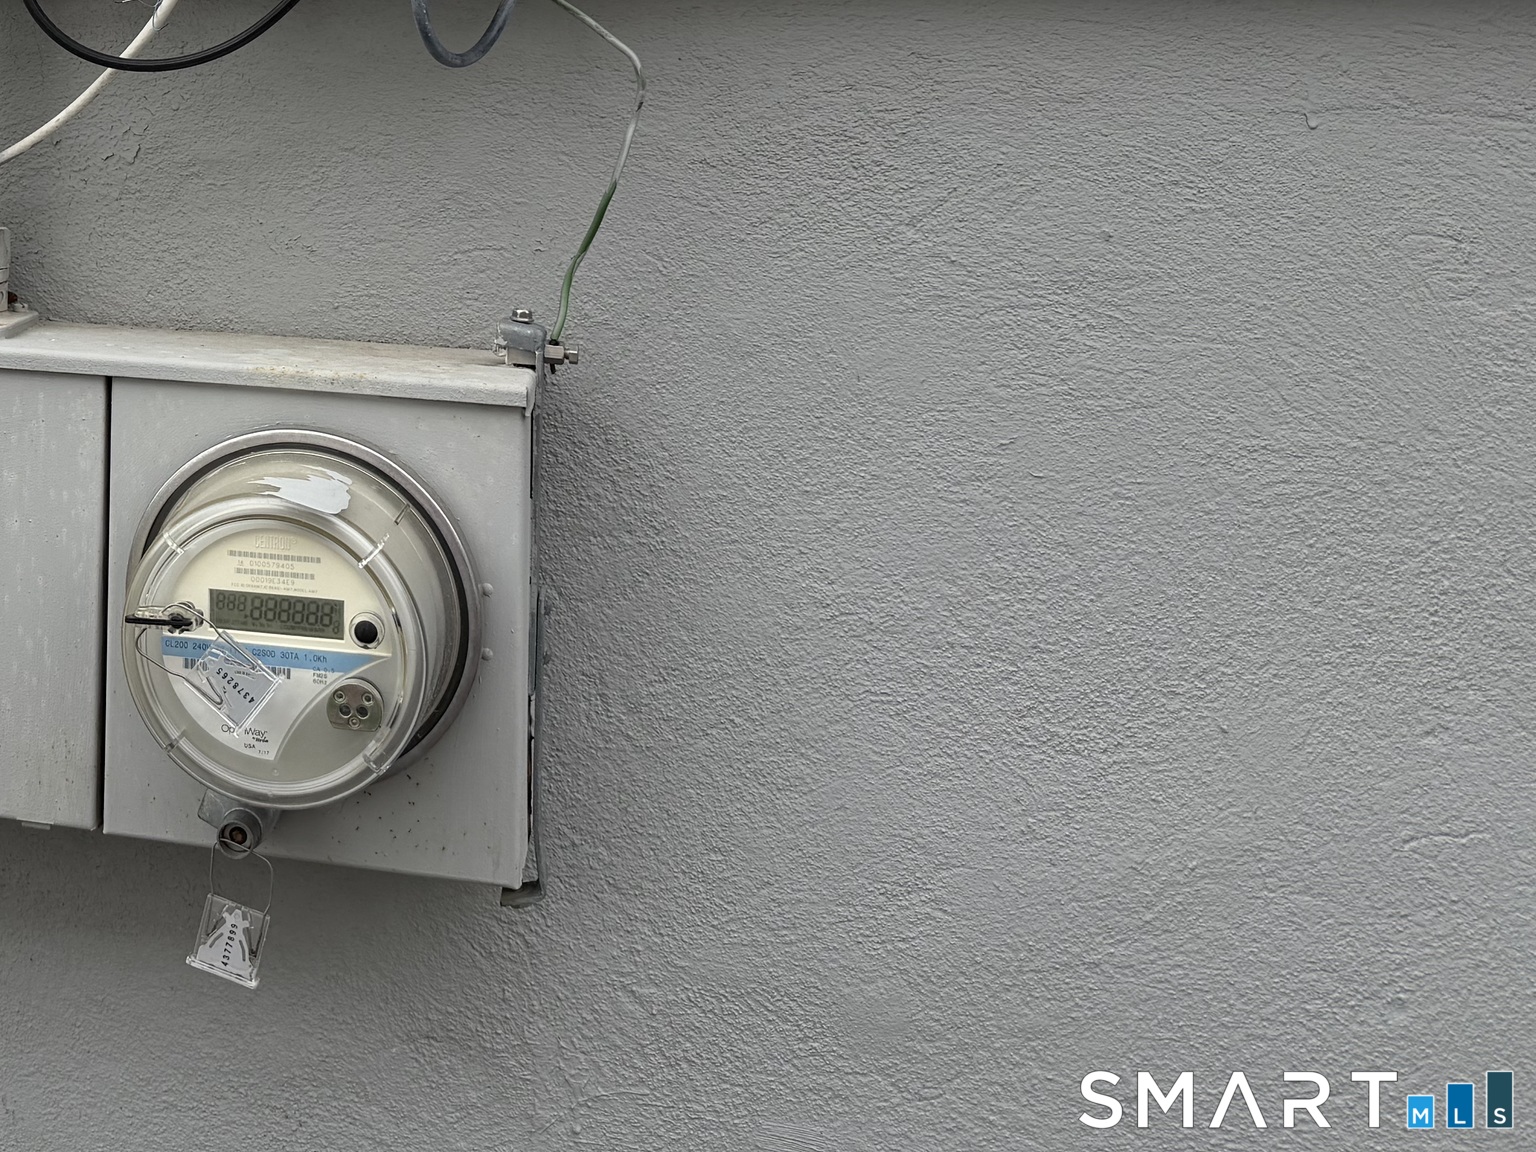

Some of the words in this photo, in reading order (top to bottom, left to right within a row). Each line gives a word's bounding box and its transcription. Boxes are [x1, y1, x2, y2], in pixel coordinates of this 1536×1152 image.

[249, 560, 295, 570] 0100579405
[250, 596, 334, 627] 888888
[165, 640, 188, 649] CL200
[280, 652, 299, 661] 30TA
[304, 653, 328, 663] 1.0Kh
[216, 667, 255, 704] 4378265
[221, 724, 266, 738] OpWay
[221, 924, 238, 966] 4377899
